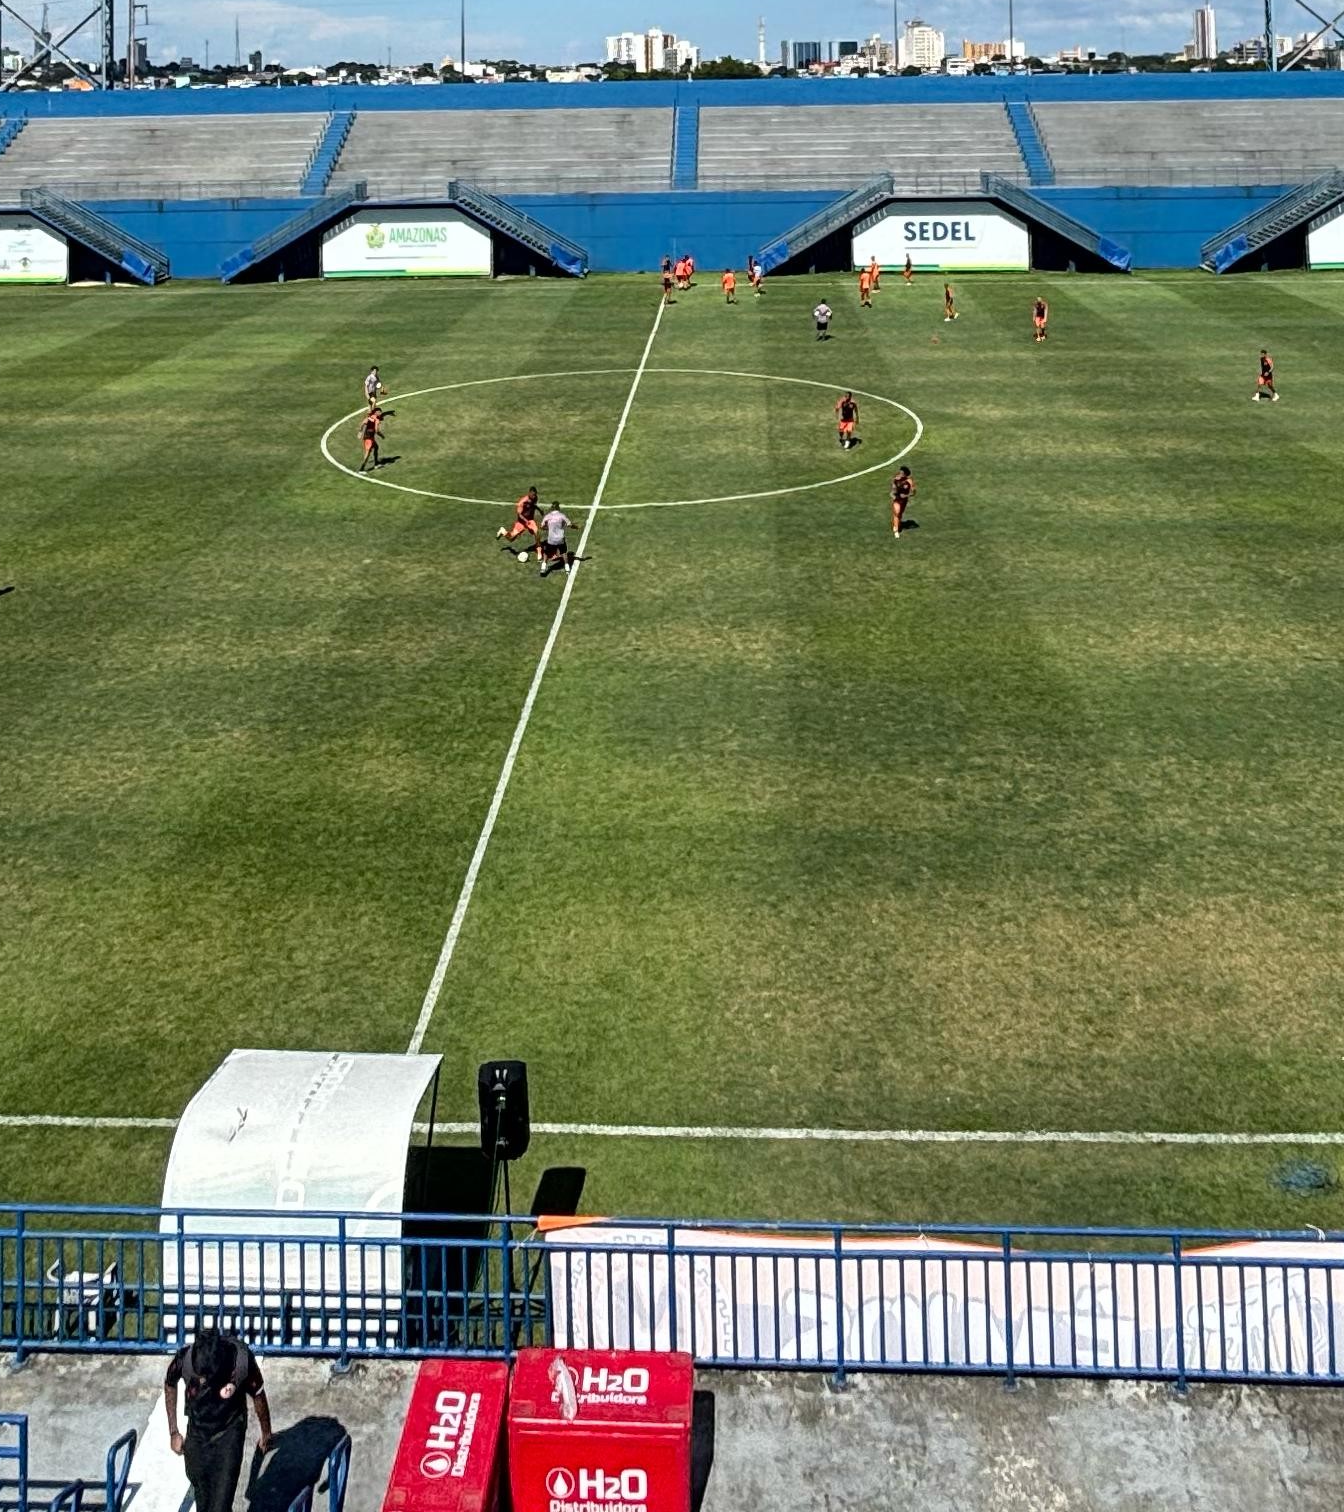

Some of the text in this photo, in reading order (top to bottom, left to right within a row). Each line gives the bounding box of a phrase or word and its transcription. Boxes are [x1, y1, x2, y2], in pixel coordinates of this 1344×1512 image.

[389, 227, 448, 244] AMAZONAS
[904, 221, 976, 242] SEDEL
[582, 1367, 650, 1393] H2O
[425, 1390, 467, 1449] H2O
[450, 1392, 482, 1478] Distribuidora
[579, 1468, 648, 1500] H2O
